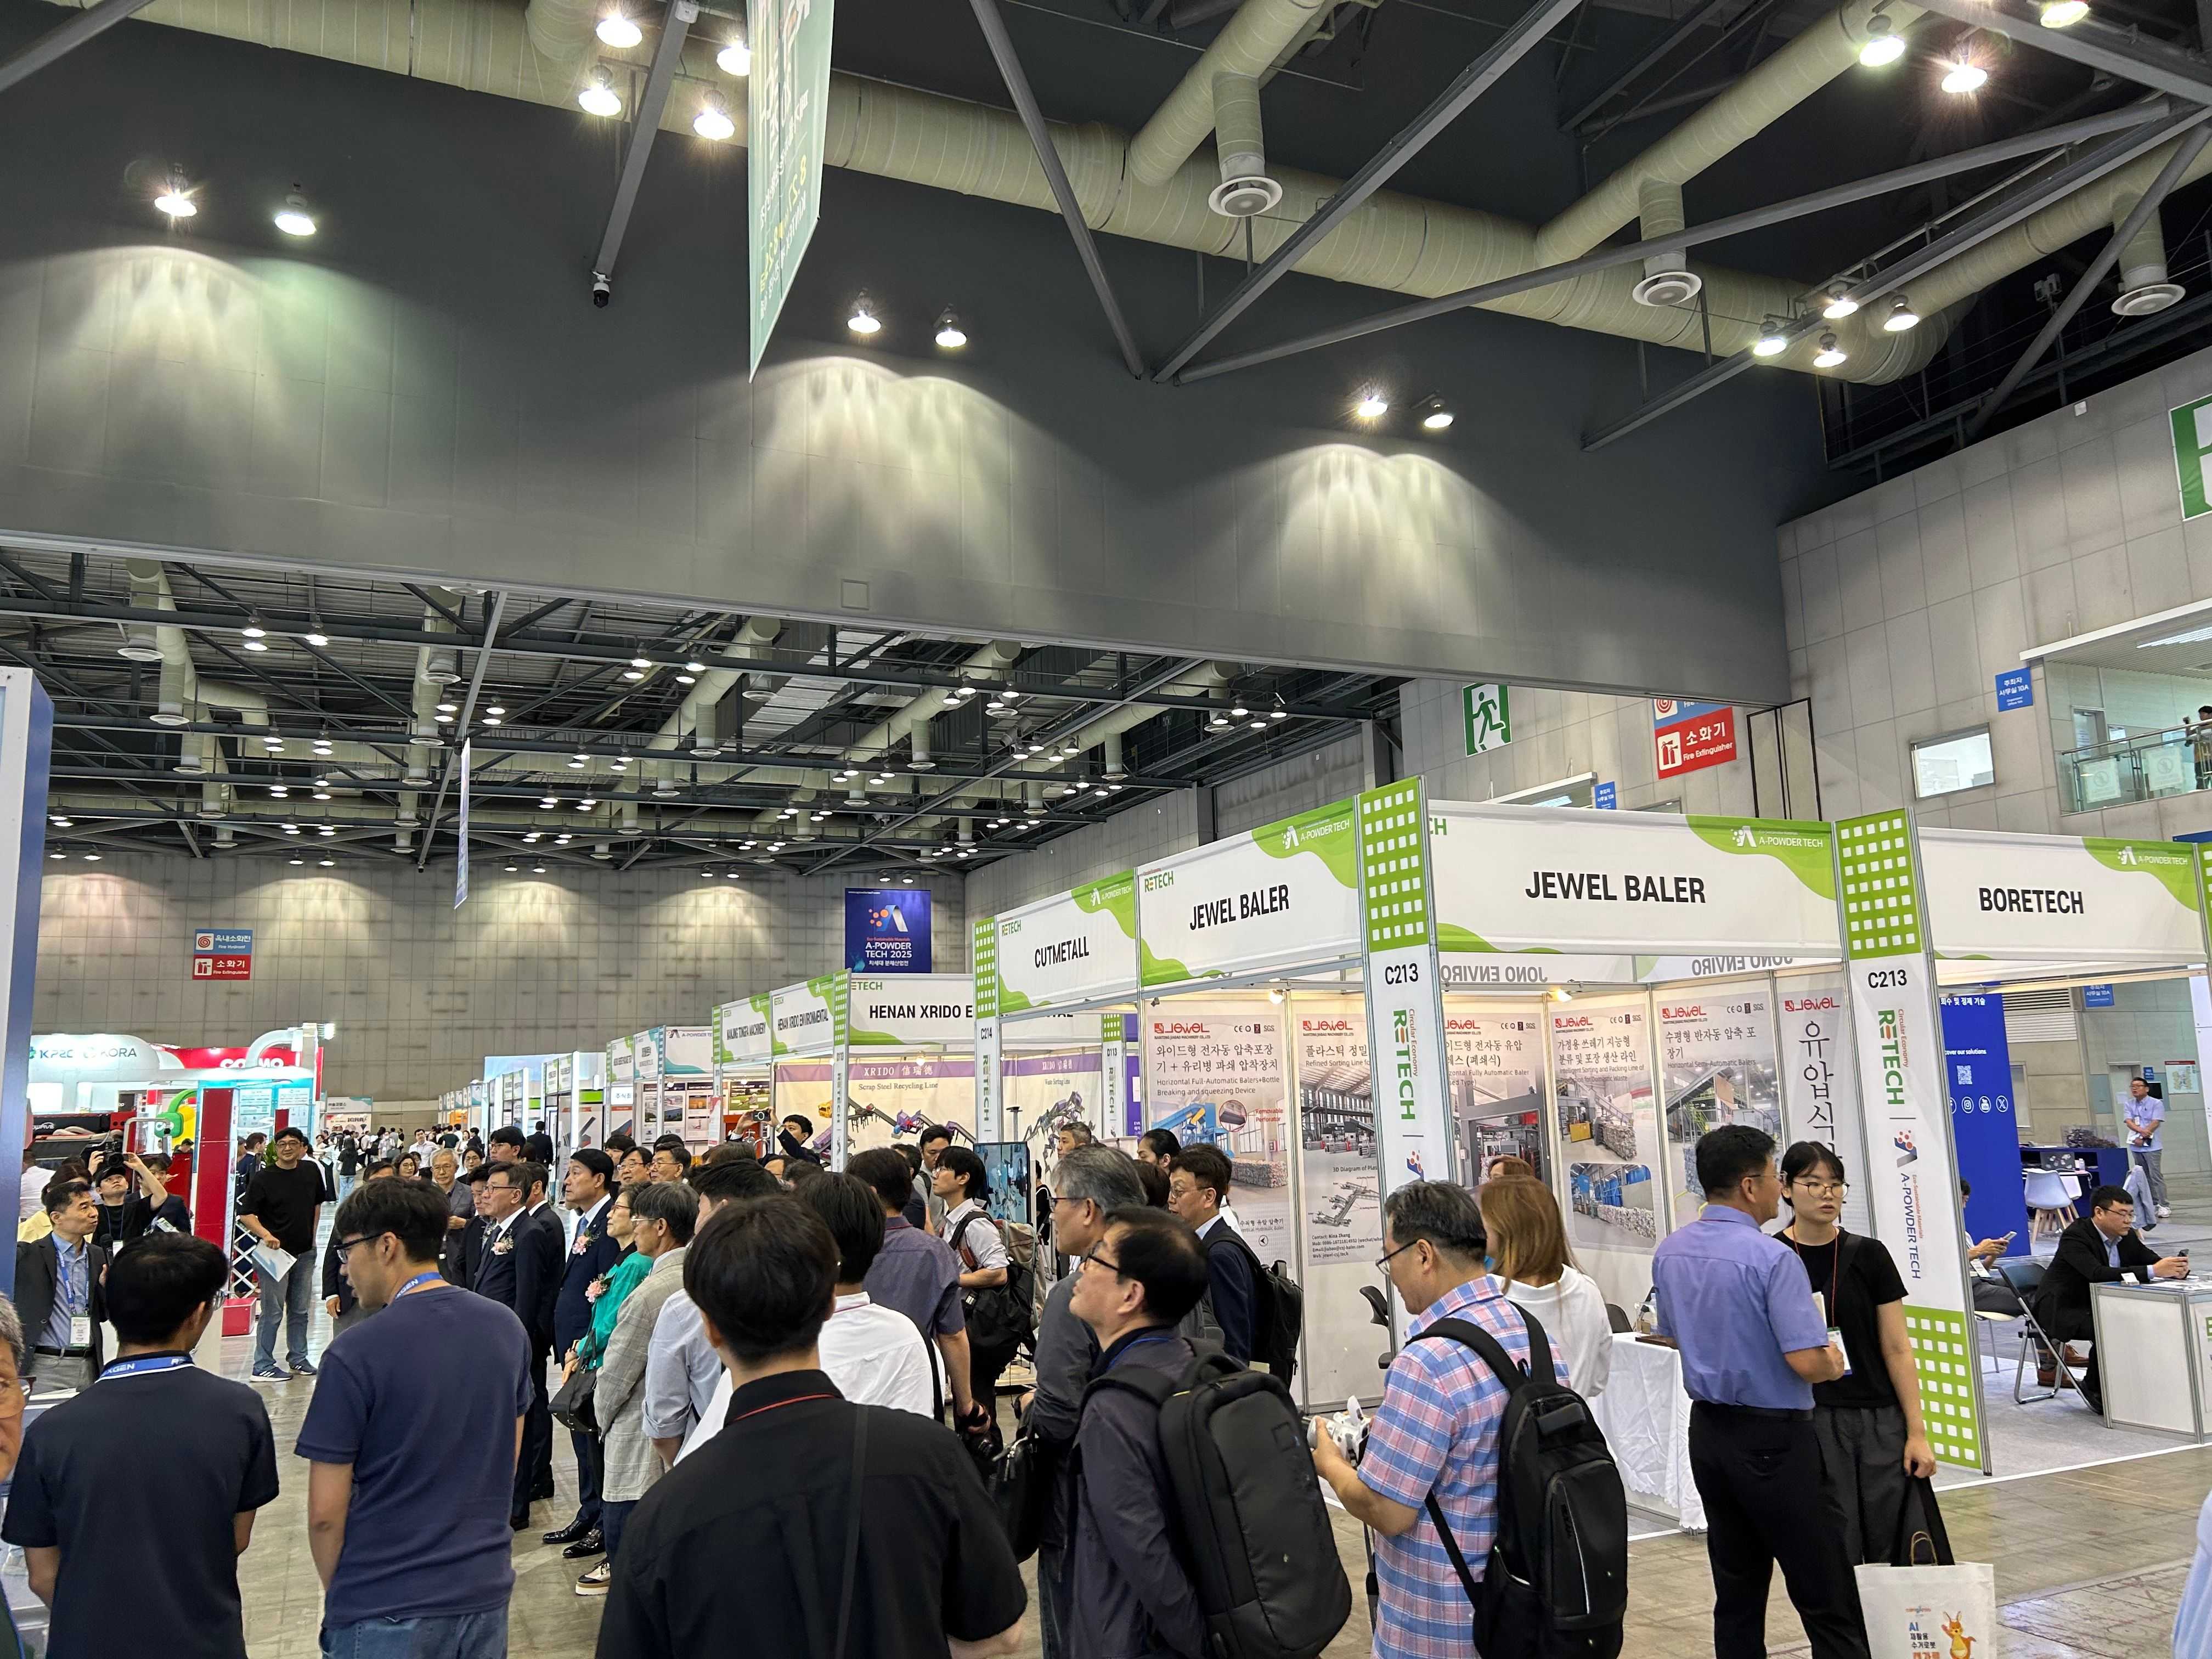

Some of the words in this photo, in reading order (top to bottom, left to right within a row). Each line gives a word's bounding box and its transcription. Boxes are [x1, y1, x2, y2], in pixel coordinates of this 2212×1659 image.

[1686, 722, 1725, 746] 소화기
[1683, 752, 1695, 761] Fire
[1696, 742, 1733, 757] Extinguisher
[1300, 824, 1333, 841] A-POWDER
[1333, 819, 1350, 832] TECH
[1759, 837, 1802, 847] A-POWDER
[1803, 838, 1823, 847] TECH
[2138, 855, 2172, 865] A-POWDER
[2172, 857, 2188, 865] TECH
[1144, 871, 1174, 892] RETECH
[1525, 871, 1617, 900] JEWEL
[1624, 875, 1706, 904] BALER
[1190, 898, 1236, 930] JEWEL
[1240, 884, 1289, 919] BALER
[1979, 888, 2084, 913] BORETECH
[1002, 919, 1021, 936] RETECH
[1035, 936, 1090, 968] CUTMETALL
[1385, 963, 1419, 985] C213
[1867, 969, 1908, 989] C213
[851, 982, 882, 990] ETECH
[870, 1005, 916, 1019] HENAN
[920, 1005, 962, 1018] XRIDO
[1409, 1008, 1417, 1039] Circular
[981, 1027, 992, 1040] C214
[1666, 1031, 1690, 1043] 수평형
[1694, 1029, 1721, 1041] 반자동
[1725, 1028, 1743, 1040] 압축
[1747, 1026, 1756, 1038] 포
[1156, 1045, 1196, 1057] 와이드형
[1201, 1044, 1230, 1056] 전자동
[1234, 1043, 1273, 1056] 압축포장
[1475, 1040, 1502, 1051] 전자동
[1505, 1040, 1522, 1051] 유압
[1558, 1039, 1579, 1051] 가정용
[1582, 1037, 1604, 1049] 쓰레기
[1607, 1035, 1629, 1048] 지능형
[1107, 1048, 1118, 1057] D113
[1306, 1045, 1344, 1057] 플라스틱
[1349, 1045, 1368, 1057] 정밀
[1559, 1054, 1573, 1065] 분류
[1576, 1053, 1583, 1065] 및
[1585, 1052, 1600, 1064] 포장
[1602, 1052, 1618, 1063] 생산
[1621, 1051, 1637, 1062] 라인
[1667, 1047, 1684, 1059] 장기
[1878, 1010, 1905, 1104] RETECH
[1901, 1036, 1909, 1067] Economy
[221, 1058, 284, 1068] COMO
[1156, 1061, 1166, 1073] 기
[1182, 1060, 1211, 1073] 유리병
[1216, 1059, 1235, 1071] 파쇄
[1239, 1059, 1278, 1071] 압착장치
[1393, 1009, 1415, 1120] RETECH
[1466, 1054, 1500, 1067] (폐쇄식)
[1695, 1059, 1737, 1068] Semi-Automatic
[864, 1066, 894, 1076] XRIDO
[1201, 1088, 1233, 1098] squeezing
[1900, 1172, 1917, 1243] A-POWDER
[1909, 1246, 1921, 1279] TECH
[1909, 1622, 1919, 1632] AI
